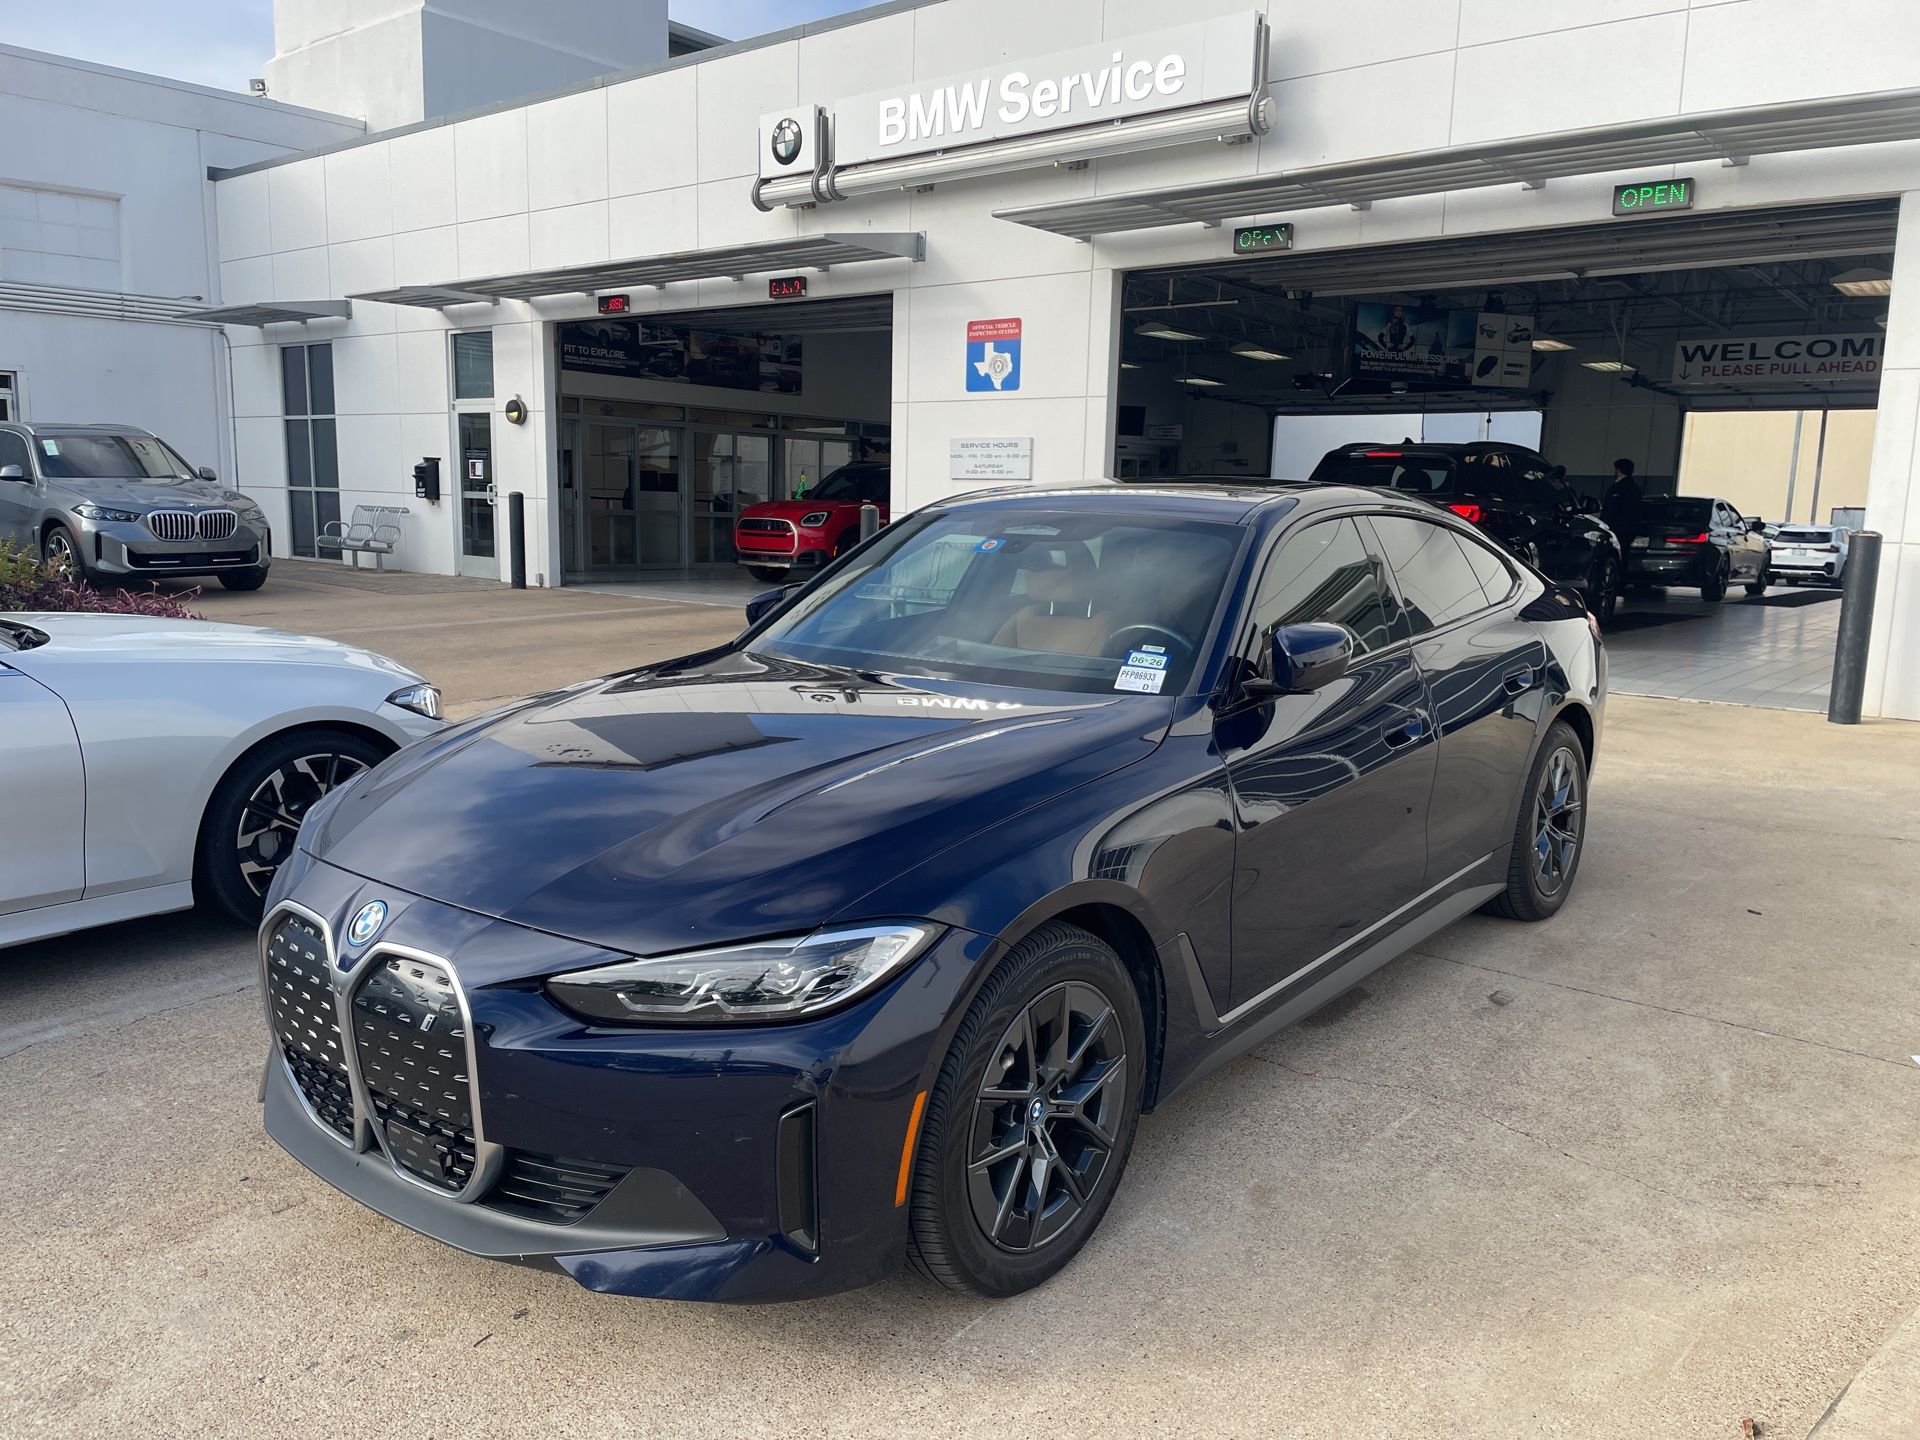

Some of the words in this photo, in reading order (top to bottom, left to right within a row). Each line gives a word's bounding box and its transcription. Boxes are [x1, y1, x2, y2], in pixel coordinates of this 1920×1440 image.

[878, 78, 991, 147] BMW
[997, 50, 1186, 122] Service
[1621, 183, 1685, 208] OPEN
[564, 344, 576, 353] FIT
[578, 346, 589, 355] TO
[1360, 350, 1405, 361] POWERFUL
[1680, 338, 1885, 363] WELCOM
[1701, 364, 1765, 377] PLEASE
[1770, 362, 1810, 376] PULL
[1816, 360, 1878, 374] AHEAD
[1131, 656, 1144, 664] 06
[1149, 658, 1163, 667] 26
[1120, 670, 1157, 681] PFP86933
